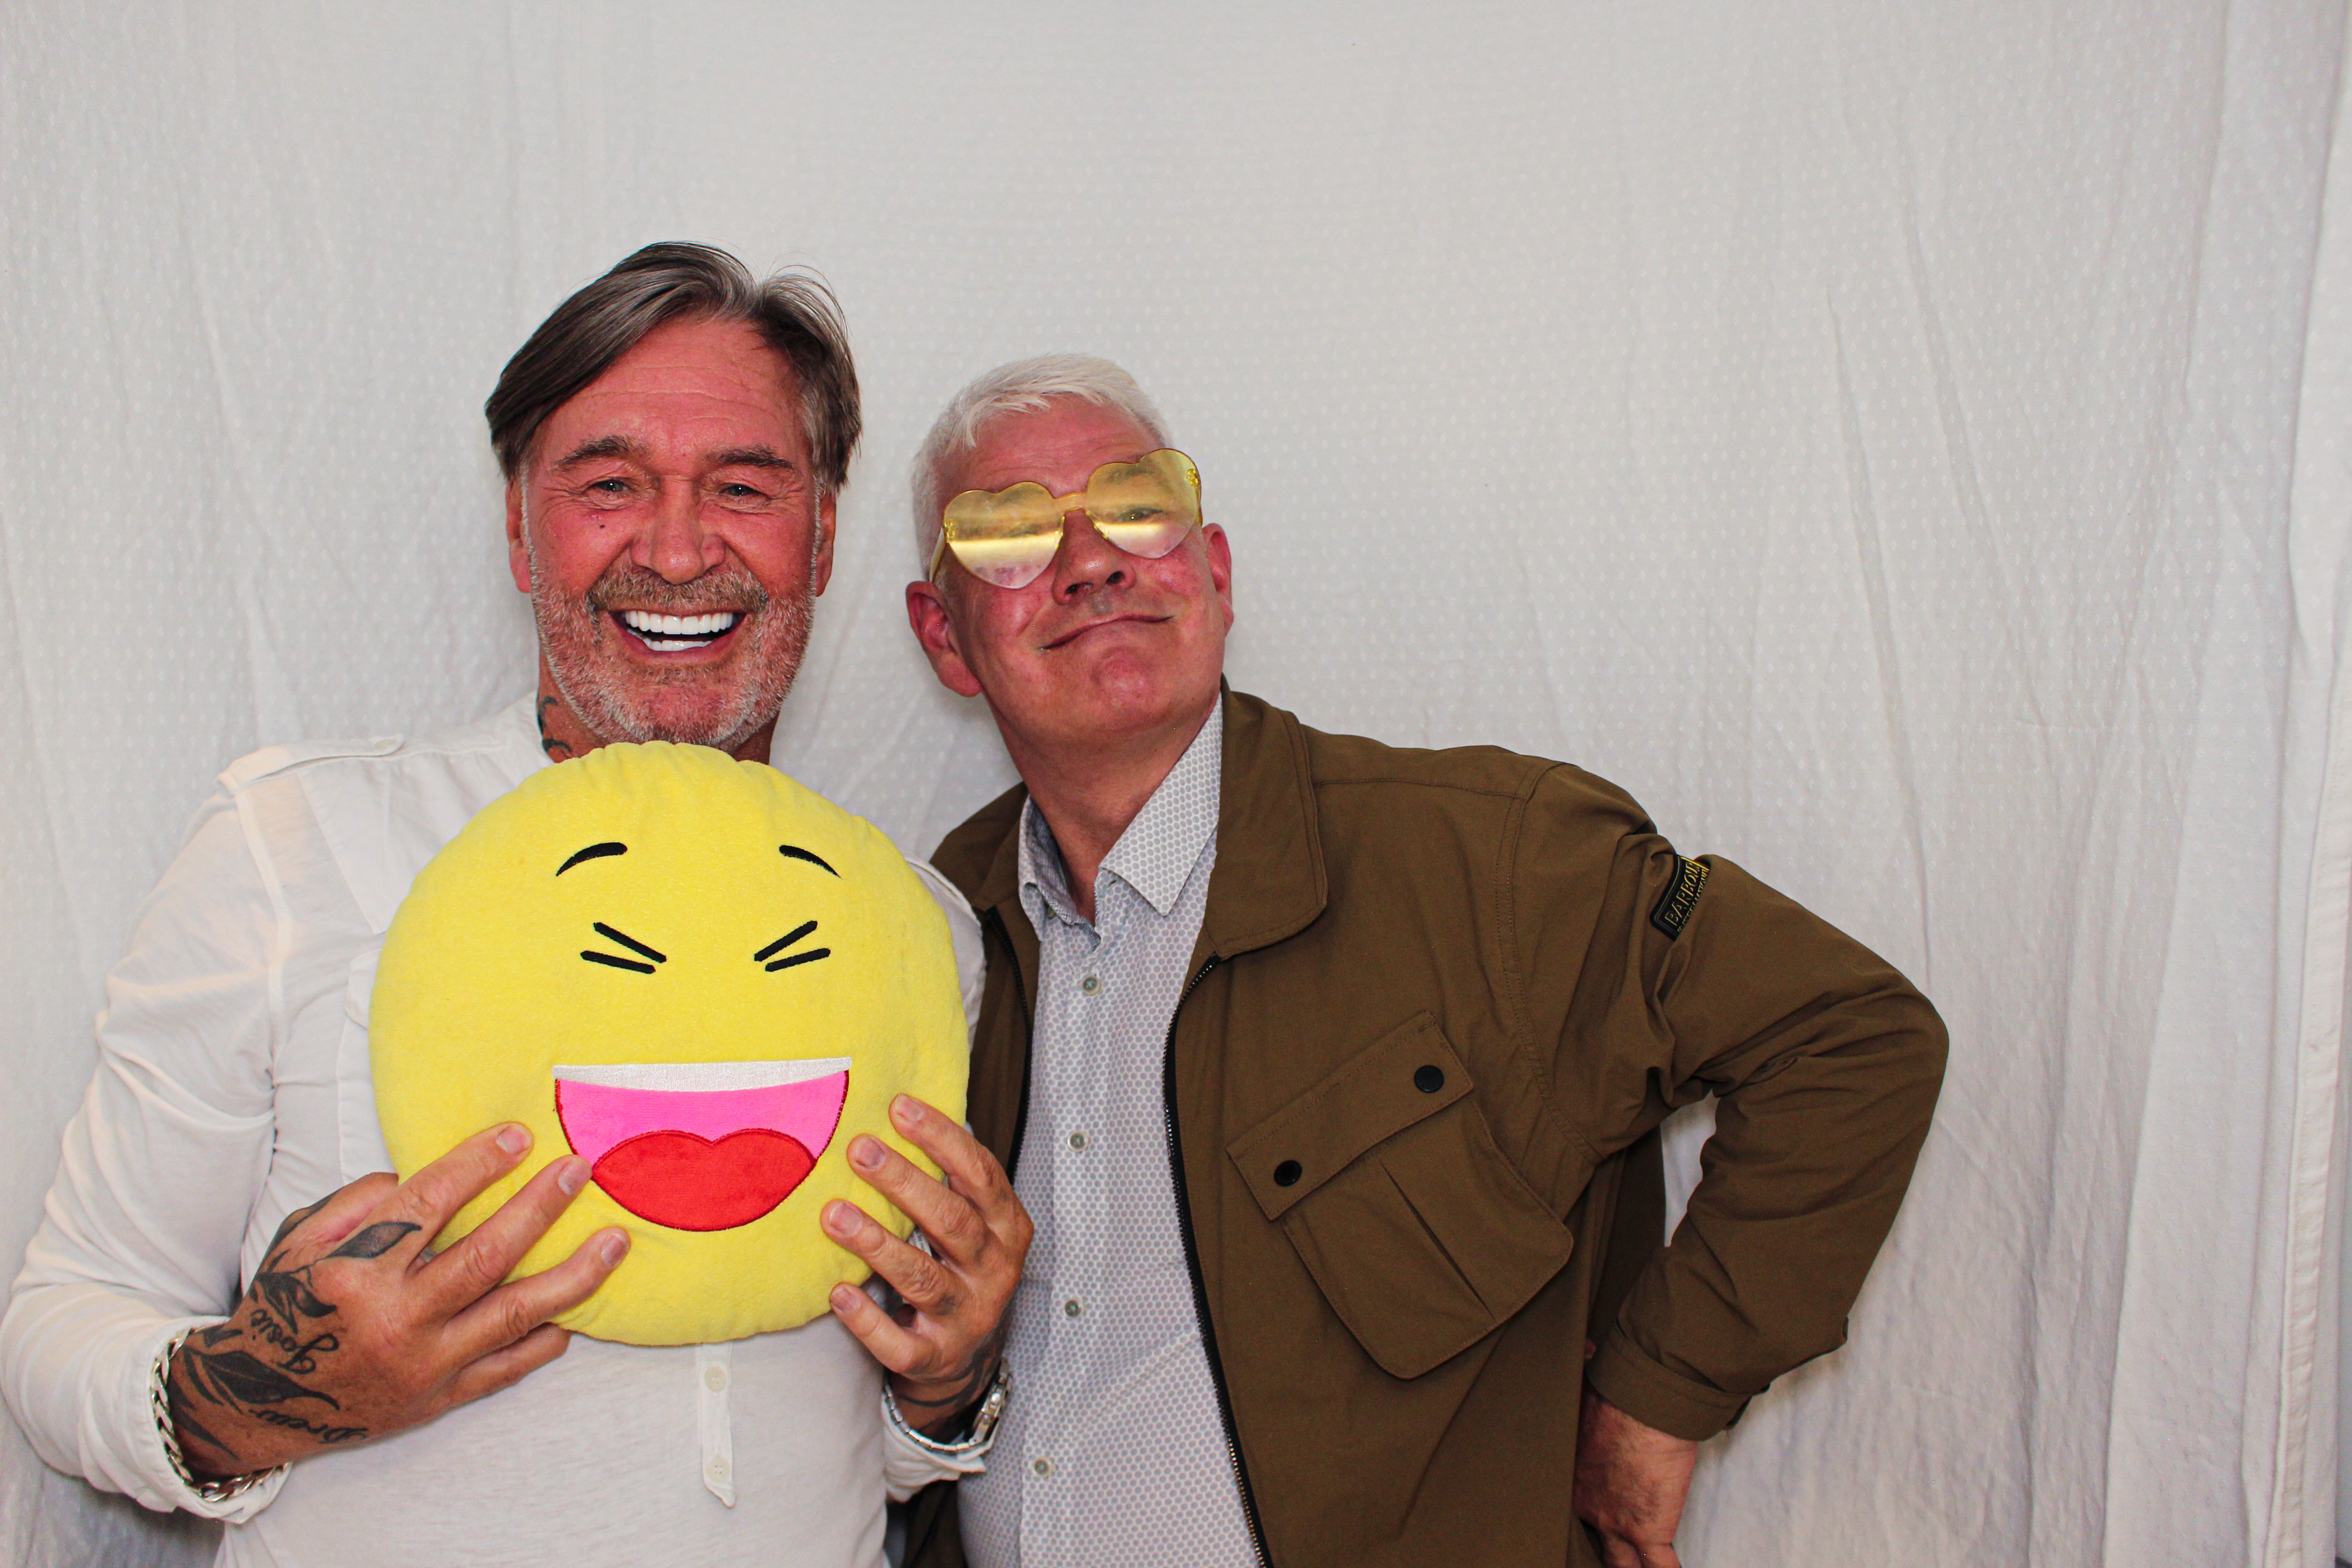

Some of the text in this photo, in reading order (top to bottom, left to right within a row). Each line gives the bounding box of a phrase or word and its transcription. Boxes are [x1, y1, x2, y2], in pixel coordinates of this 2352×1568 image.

[1665, 862, 1700, 926] BARBOUR
[251, 1309, 339, 1375] Josie
[249, 1410, 368, 1444] Drew
